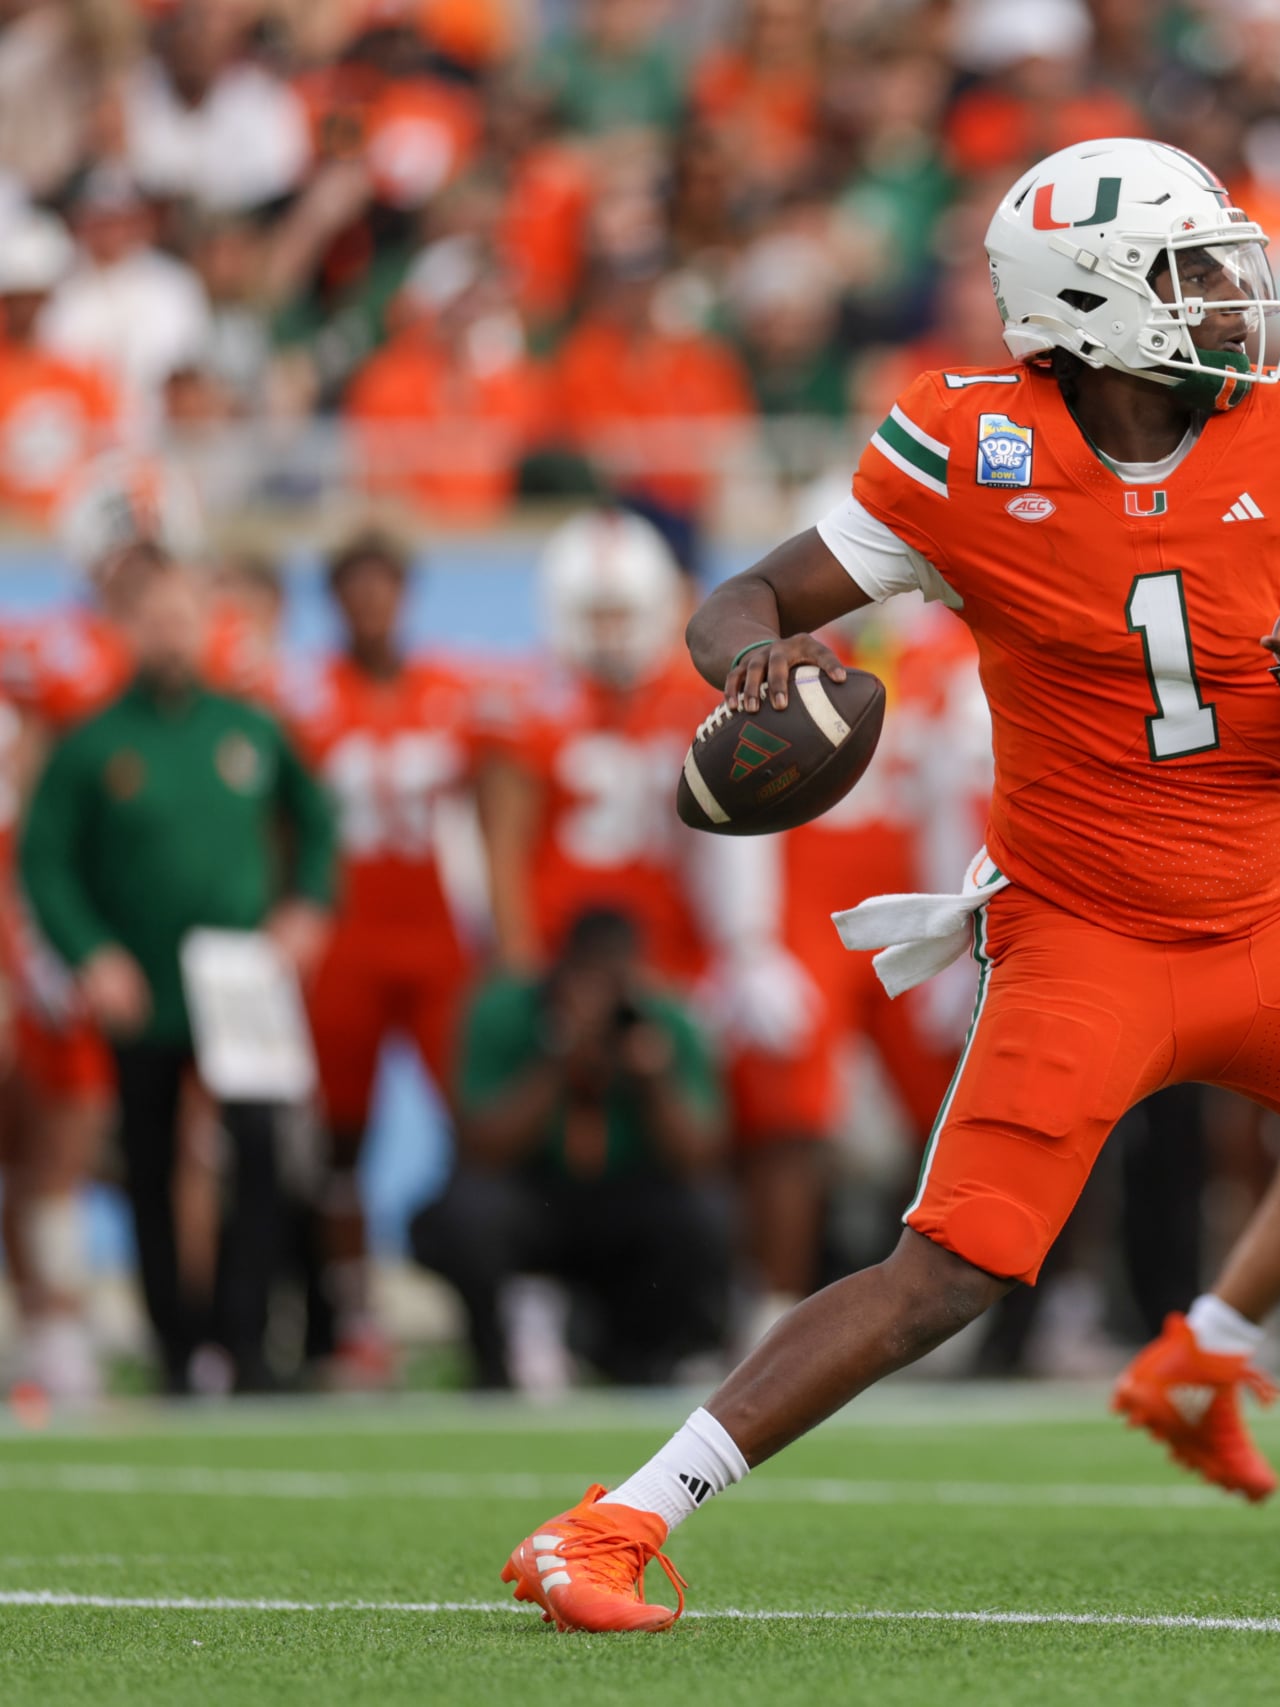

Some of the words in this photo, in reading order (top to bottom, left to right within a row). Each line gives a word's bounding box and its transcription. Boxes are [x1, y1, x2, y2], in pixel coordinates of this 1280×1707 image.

[1032, 176, 1122, 231] U
[943, 372, 1021, 389] 1
[991, 472, 1016, 480] BOWL
[1014, 501, 1048, 511] ACC
[1124, 490, 1167, 517] U
[1125, 569, 1220, 762] 1
